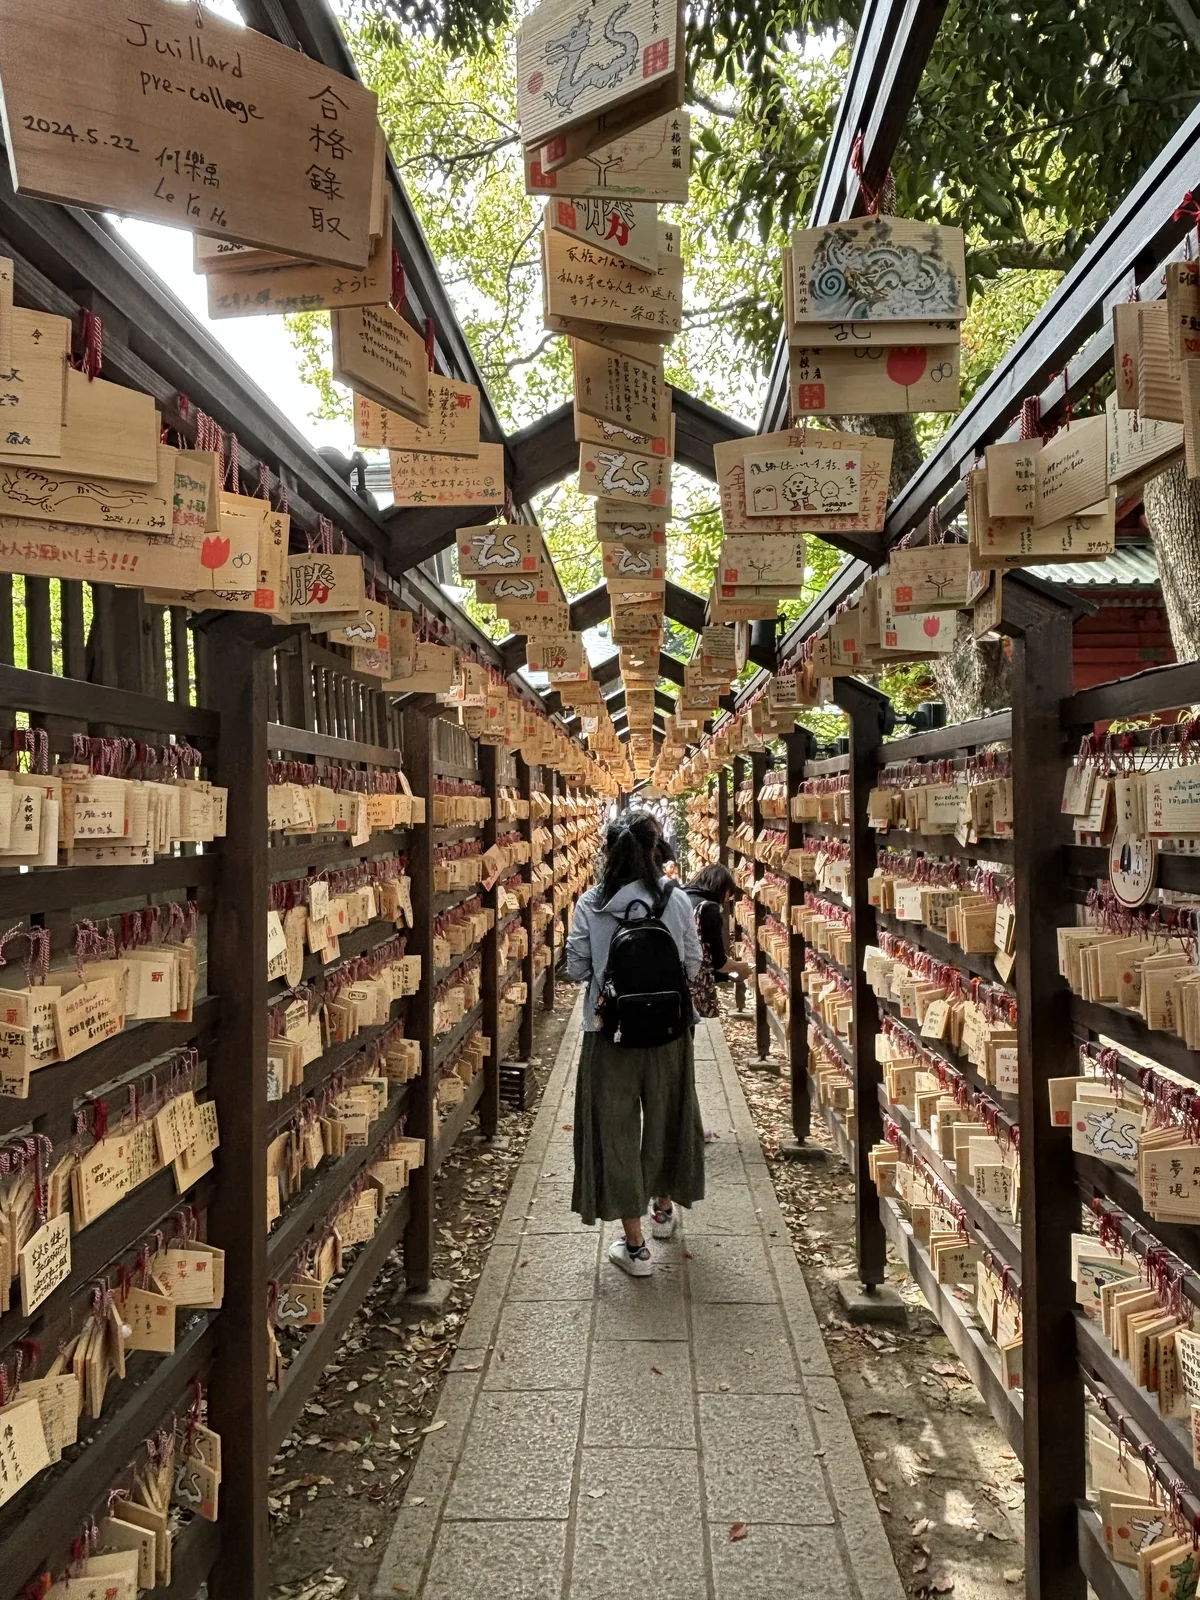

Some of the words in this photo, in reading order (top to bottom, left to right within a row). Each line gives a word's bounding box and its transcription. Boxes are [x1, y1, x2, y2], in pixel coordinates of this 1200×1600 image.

[127, 18, 243, 79] Juillard
[140, 70, 264, 123] pre-college
[23, 115, 140, 152] 2024.5.22
[154, 177, 175, 203] Le
[359, 400, 371, 439] 氷川神社
[289, 563, 337, 606] 勝
